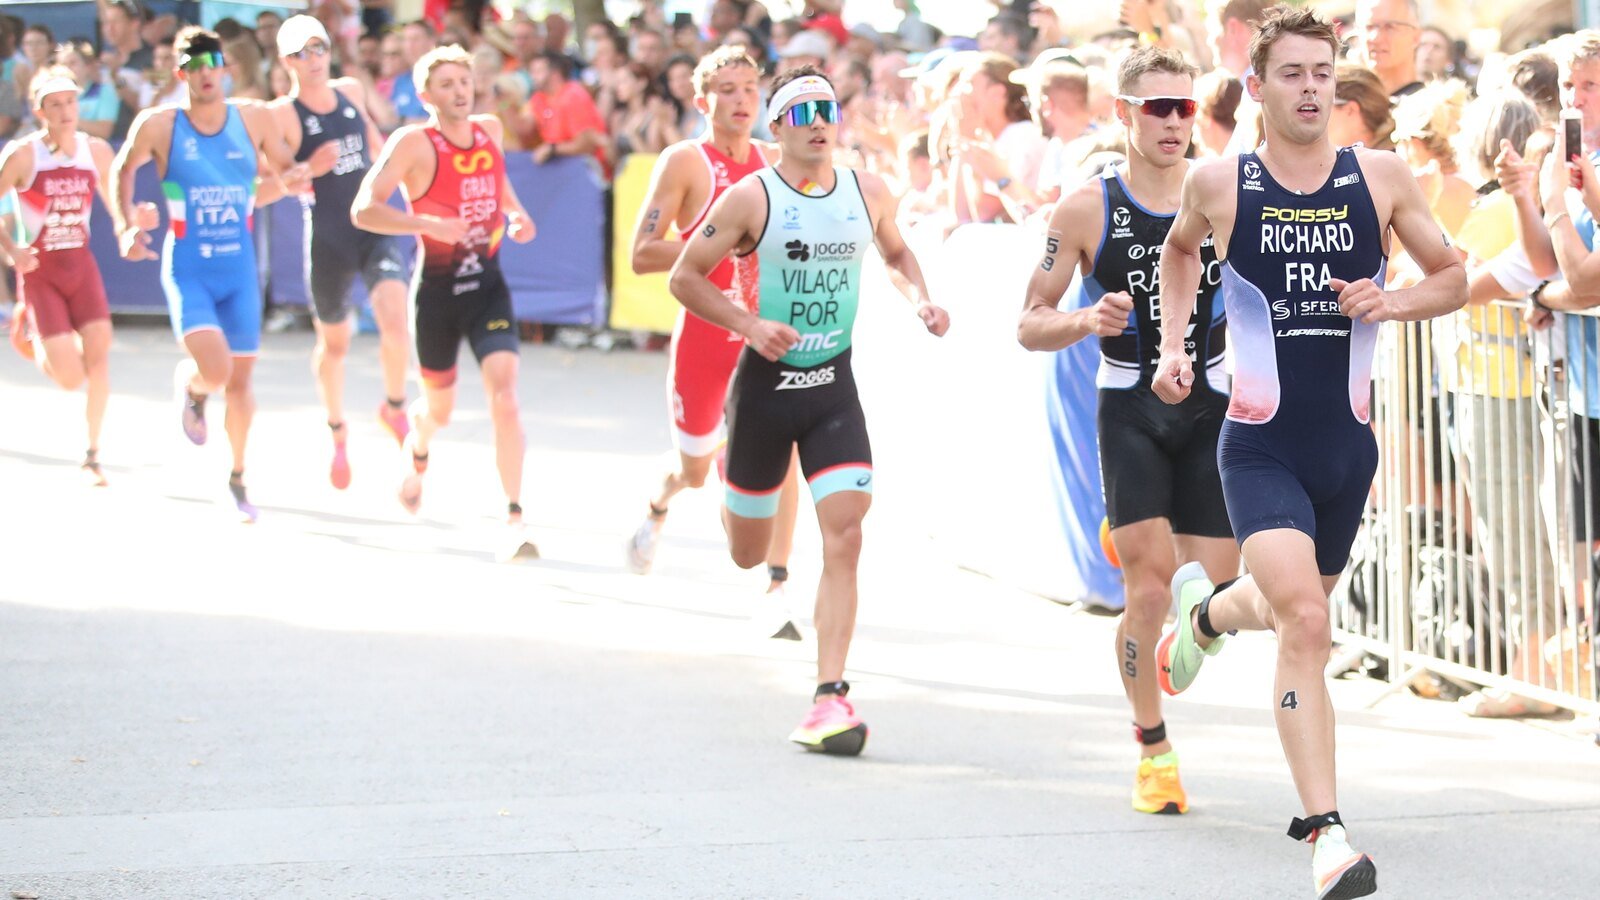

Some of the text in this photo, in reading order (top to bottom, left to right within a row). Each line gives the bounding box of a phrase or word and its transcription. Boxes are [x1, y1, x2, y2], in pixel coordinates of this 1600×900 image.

[332, 152, 365, 175] GBR
[190, 185, 247, 206] POZZATTI
[460, 174, 496, 199] GRAU
[1242, 184, 1265, 192] Triathlon
[53, 195, 83, 211] HUN
[459, 199, 497, 223] ESP
[1261, 205, 1348, 222] POISSY
[196, 206, 240, 226] ITA
[703, 224, 717, 238] 9
[1260, 222, 1354, 254] RICHARD
[813, 242, 857, 259] JOGOS
[1041, 237, 1059, 272] 59
[782, 268, 850, 299] VILAÇA
[1285, 262, 1335, 293] FRA
[789, 301, 839, 326] POR
[1149, 289, 1204, 320] ET
[1276, 329, 1350, 337] LAPIERRE
[775, 366, 836, 391] ZOGGS
[1125, 641, 1138, 678] 59
[1281, 691, 1298, 710] 4
